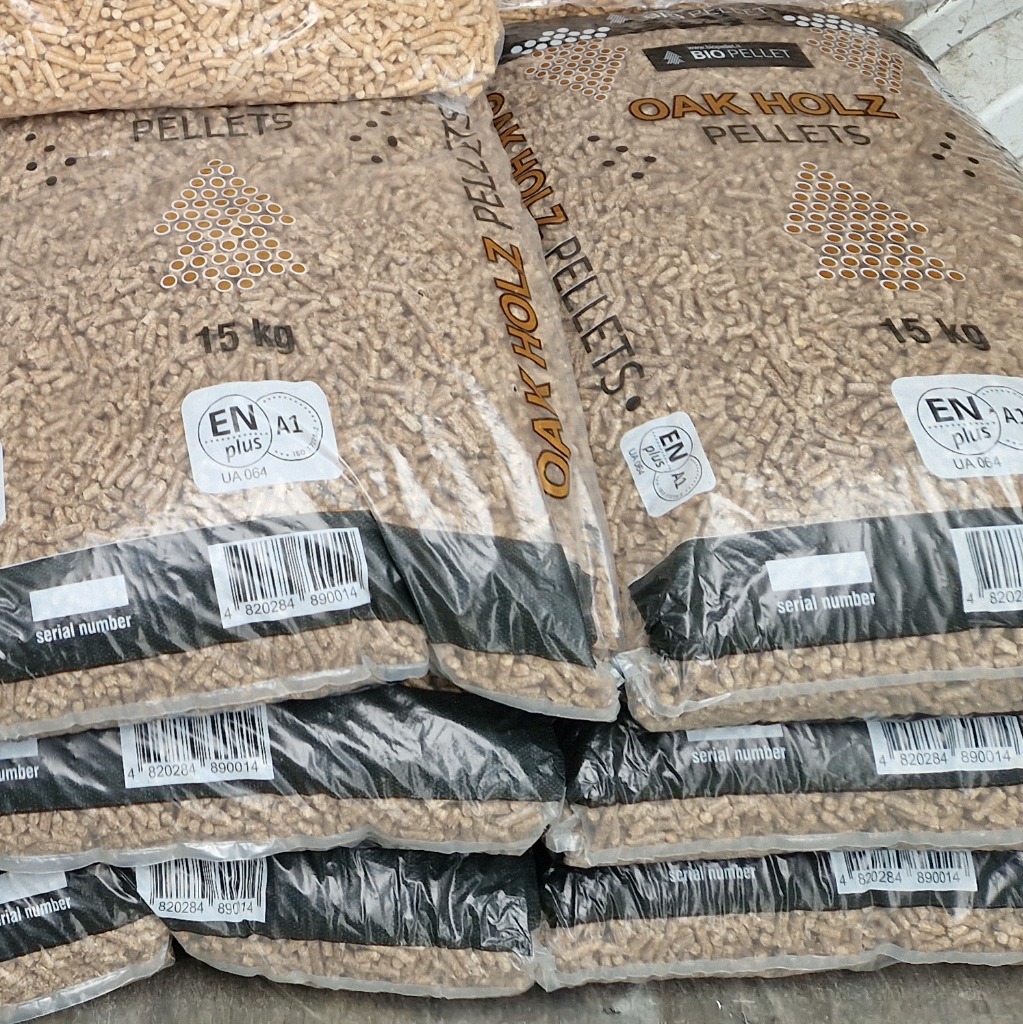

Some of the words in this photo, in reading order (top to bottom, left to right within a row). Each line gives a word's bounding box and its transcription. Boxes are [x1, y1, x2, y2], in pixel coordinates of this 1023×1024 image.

[628, 92, 746, 122] OAK
[749, 92, 901, 119] HOLZ
[132, 112, 293, 143] PELLETS
[702, 123, 872, 147] PELLETS
[483, 235, 548, 370] HOLZ
[546, 236, 644, 397] PELLETS
[196, 323, 239, 354] 15
[252, 318, 295, 355] kg
[880, 317, 931, 346] 15
[936, 317, 991, 351] kg
[209, 404, 258, 437] EN
[925, 396, 983, 423] EN
[276, 414, 304, 436] A1
[516, 366, 572, 500] OAK
[225, 436, 263, 463] plus
[659, 429, 689, 463] EN
[952, 425, 992, 450] plus
[293, 449, 306, 457] ISO
[642, 445, 665, 468] plus
[953, 458, 975, 470] UA
[977, 458, 1002, 469] 064
[221, 470, 242, 484] UA
[243, 467, 268, 481] 064
[671, 471, 687, 490] A1
[224, 609, 232, 620] 4
[245, 598, 295, 616] 820284
[310, 589, 358, 607] 890014
[777, 594, 818, 614] serial
[822, 590, 876, 610] number
[966, 593, 975, 604] 4
[35, 621, 75, 644] serial
[78, 612, 132, 638] number
[693, 747, 731, 765] serial
[734, 745, 787, 761] number
[879, 756, 887, 766] 4
[900, 753, 948, 766] 820284
[961, 750, 1012, 763] 890014
[127, 769, 135, 779] 4
[148, 764, 196, 778] 820284
[210, 761, 258, 774] 890014
[668, 867, 706, 883] serial
[708, 864, 757, 880] number
[839, 876, 846, 885] 4
[858, 871, 902, 885] 820284
[917, 871, 961, 884] 890014
[25, 896, 71, 919] number
[158, 901, 204, 914] 820284
